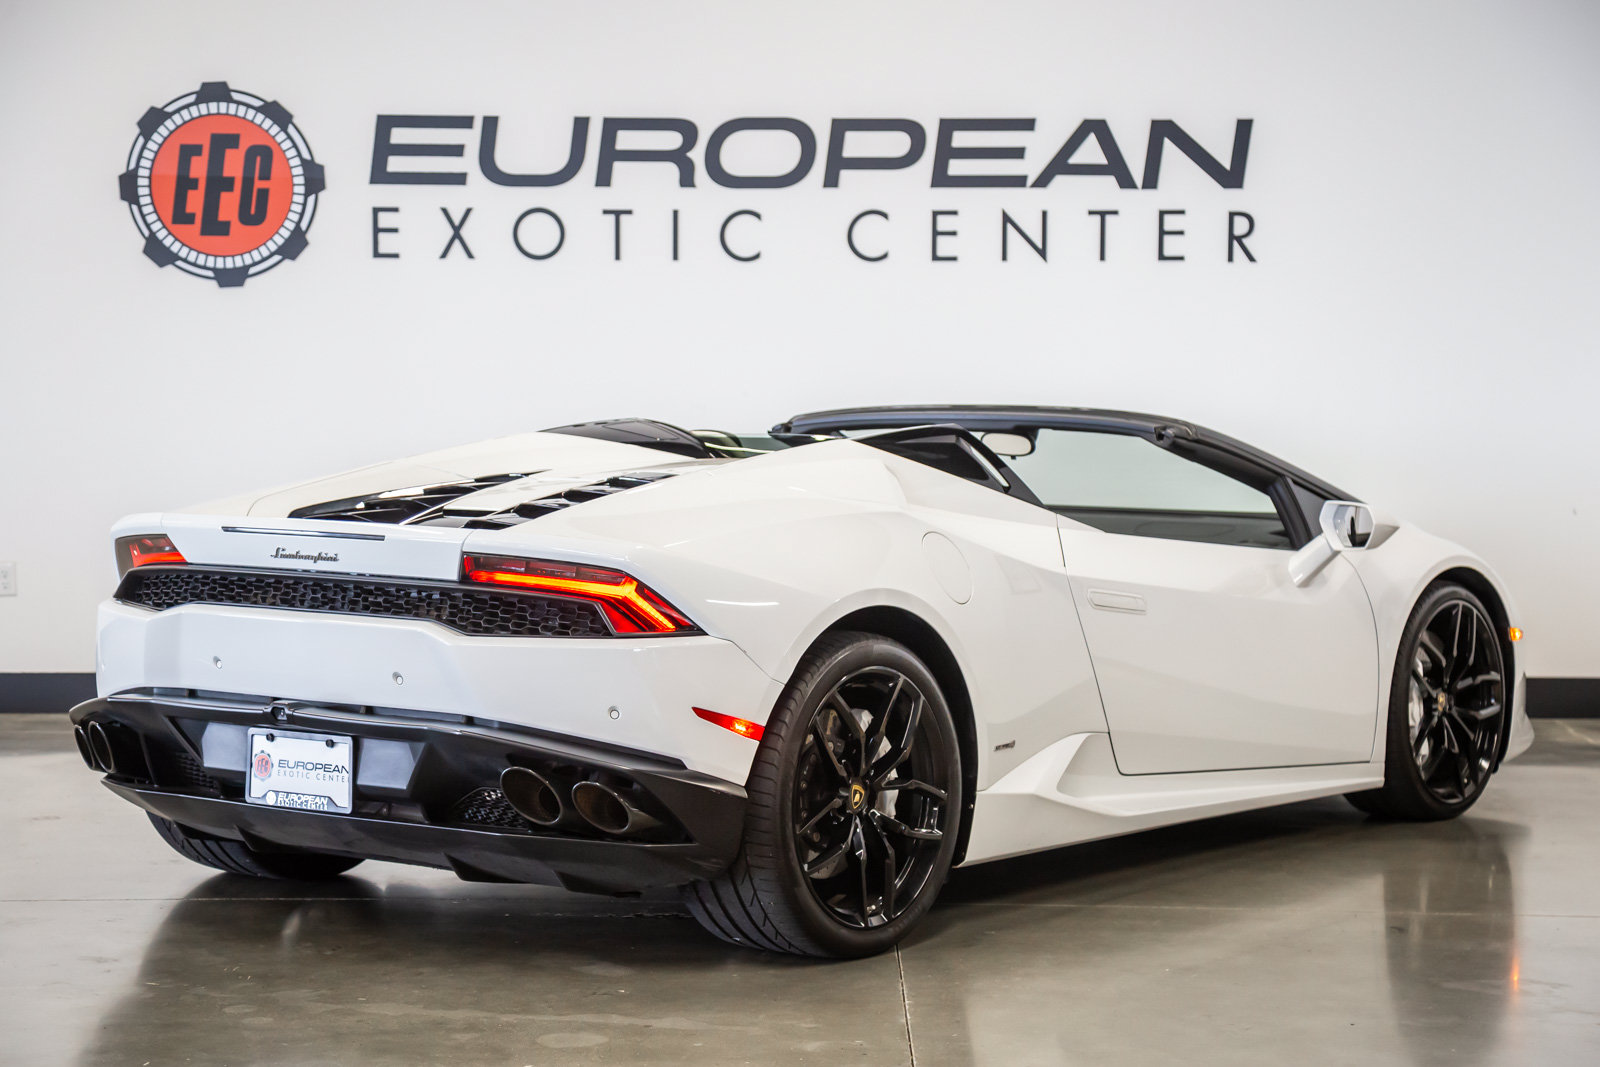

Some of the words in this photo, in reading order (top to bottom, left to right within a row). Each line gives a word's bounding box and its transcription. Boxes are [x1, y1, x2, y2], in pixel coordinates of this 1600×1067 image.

[369, 114, 1254, 190] EUROPEAN
[171, 132, 274, 236] EEC
[371, 207, 762, 262] EXOTIC
[847, 209, 1257, 264] CENTER
[277, 769, 312, 780] EXOTIC
[316, 771, 349, 783] CENTE
[278, 759, 349, 774] EUROPEAN
[278, 792, 328, 804] EUROPEAN
